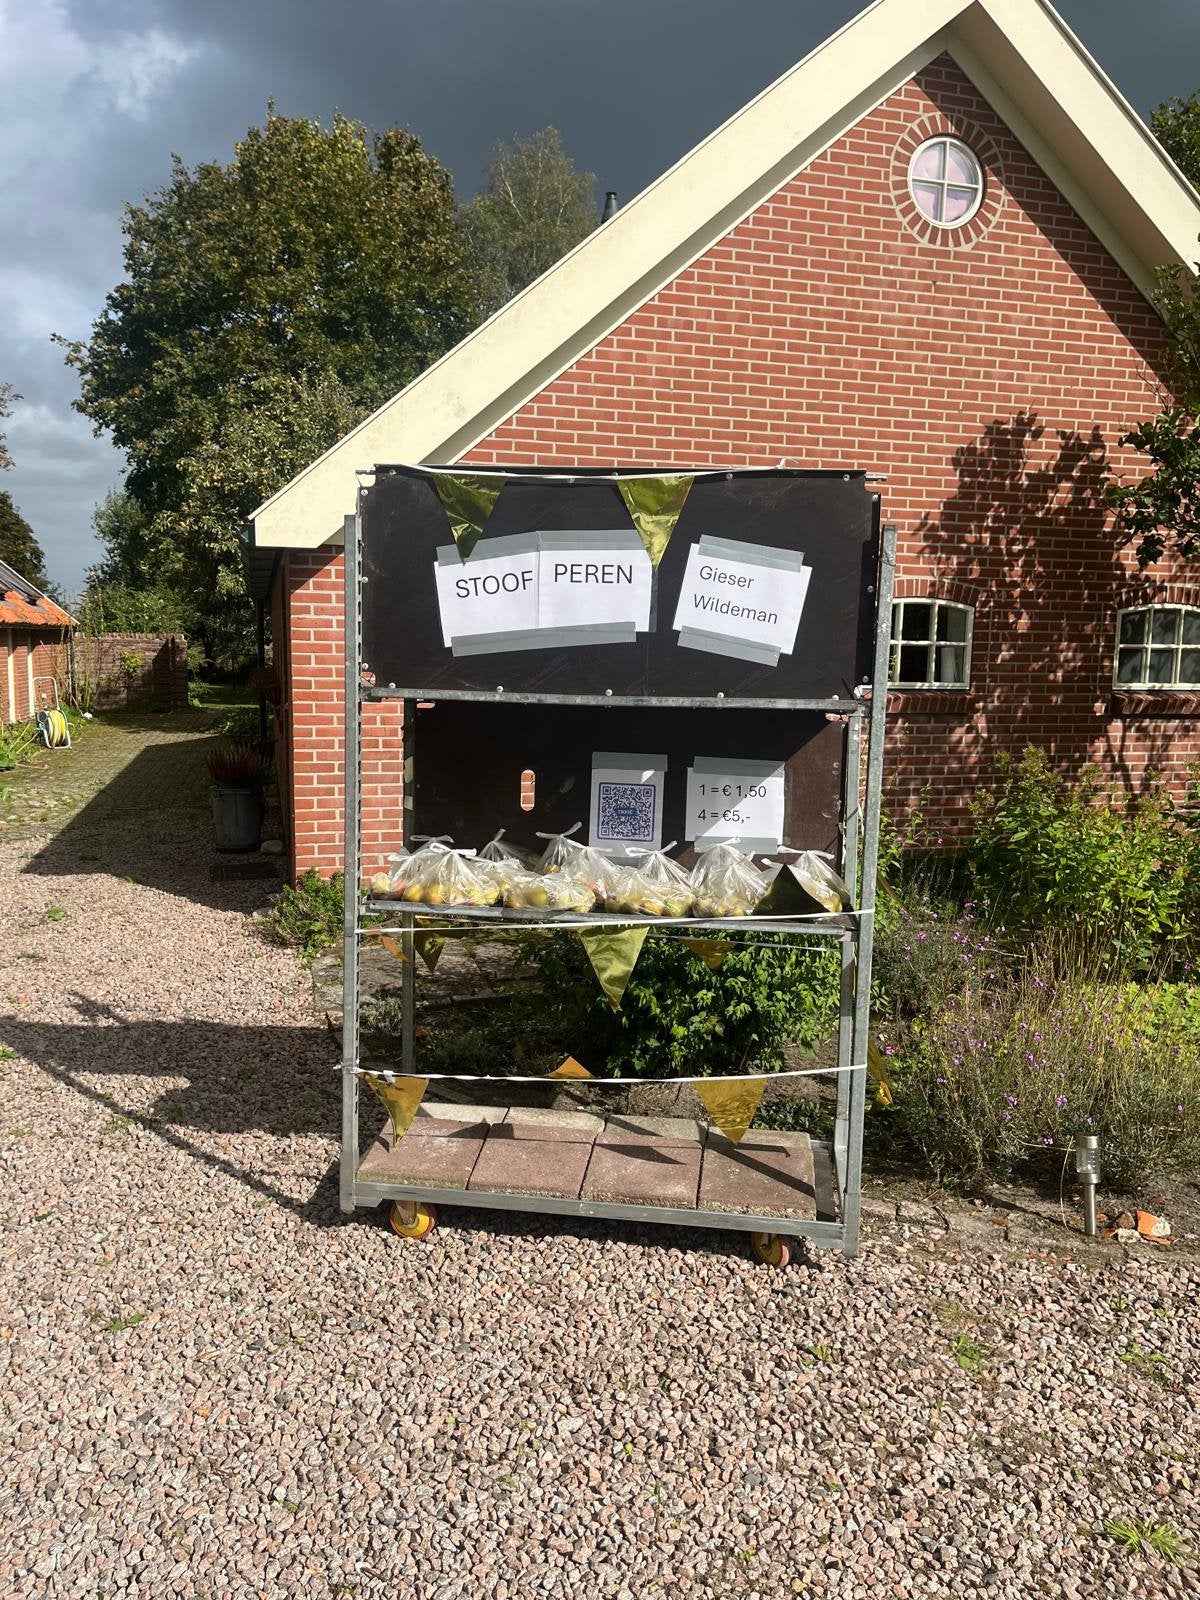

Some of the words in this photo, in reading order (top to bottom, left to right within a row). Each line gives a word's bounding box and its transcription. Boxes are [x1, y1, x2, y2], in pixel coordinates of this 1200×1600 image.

[455, 570, 533, 598] STOOF
[554, 563, 633, 584] PEREN
[699, 565, 754, 588] Gieser
[693, 593, 778, 624] Wildeman
[697, 808, 707, 820] 4
